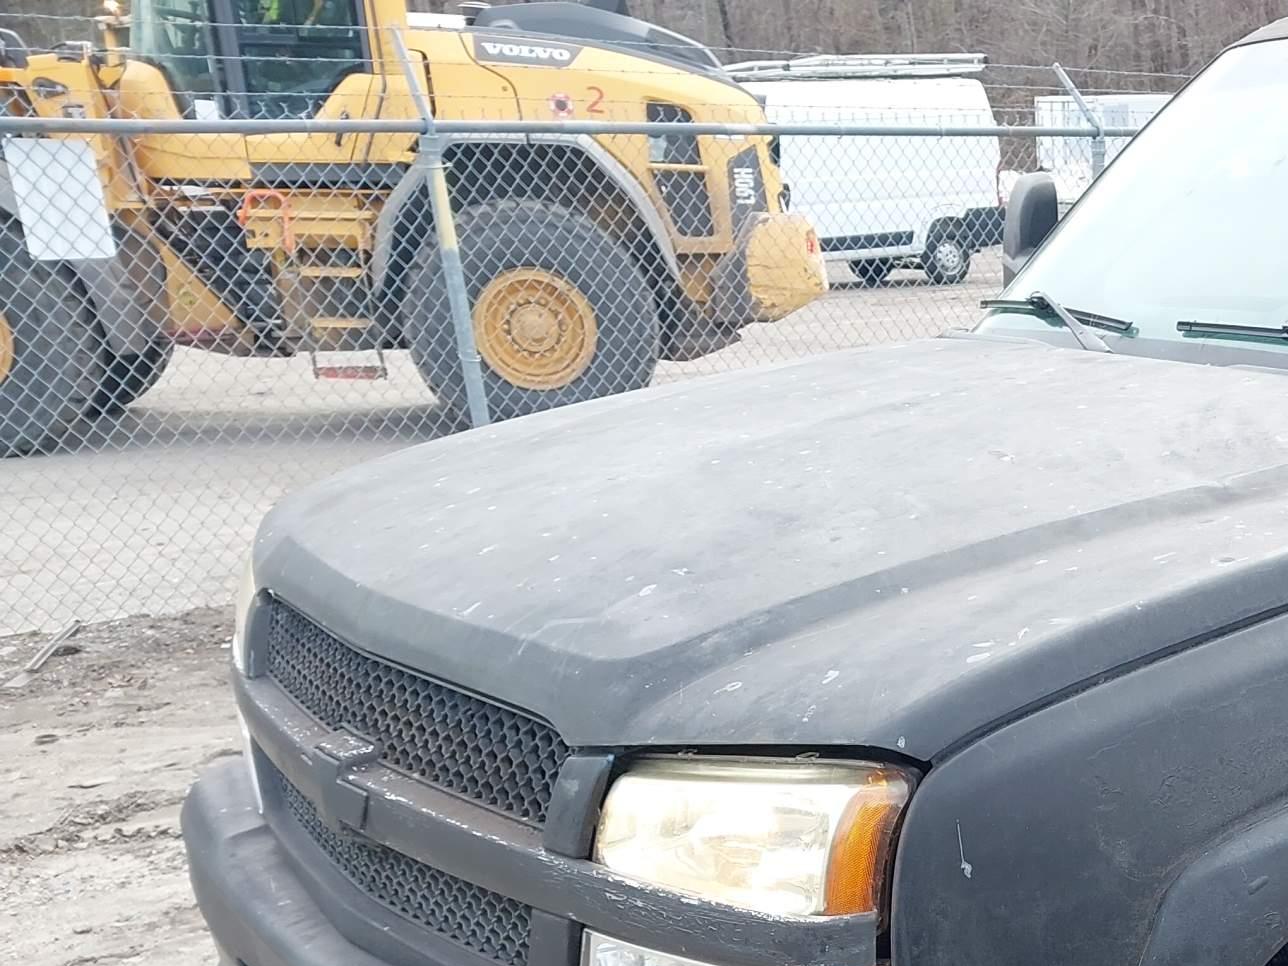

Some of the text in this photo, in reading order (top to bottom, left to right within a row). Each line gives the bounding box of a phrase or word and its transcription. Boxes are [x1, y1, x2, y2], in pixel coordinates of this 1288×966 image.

[481, 42, 570, 60] VOLVO
[586, 86, 605, 113] 2
[733, 167, 756, 205] L90H
